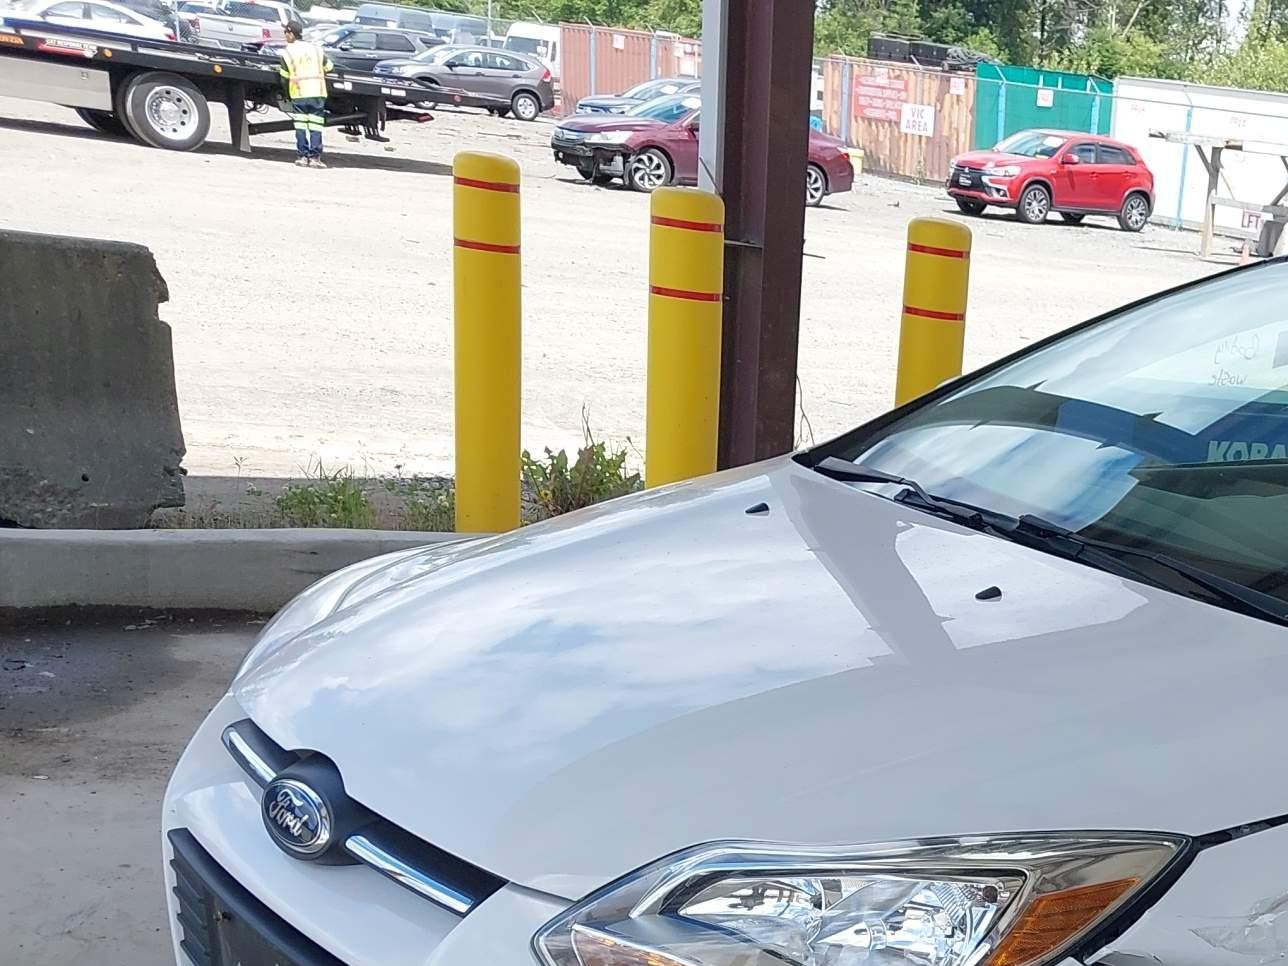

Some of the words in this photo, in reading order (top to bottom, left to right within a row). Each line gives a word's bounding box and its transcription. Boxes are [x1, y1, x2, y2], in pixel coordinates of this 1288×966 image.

[911, 107, 925, 119] VIC
[905, 119, 928, 132] AREA
[269, 788, 309, 837] Ford
